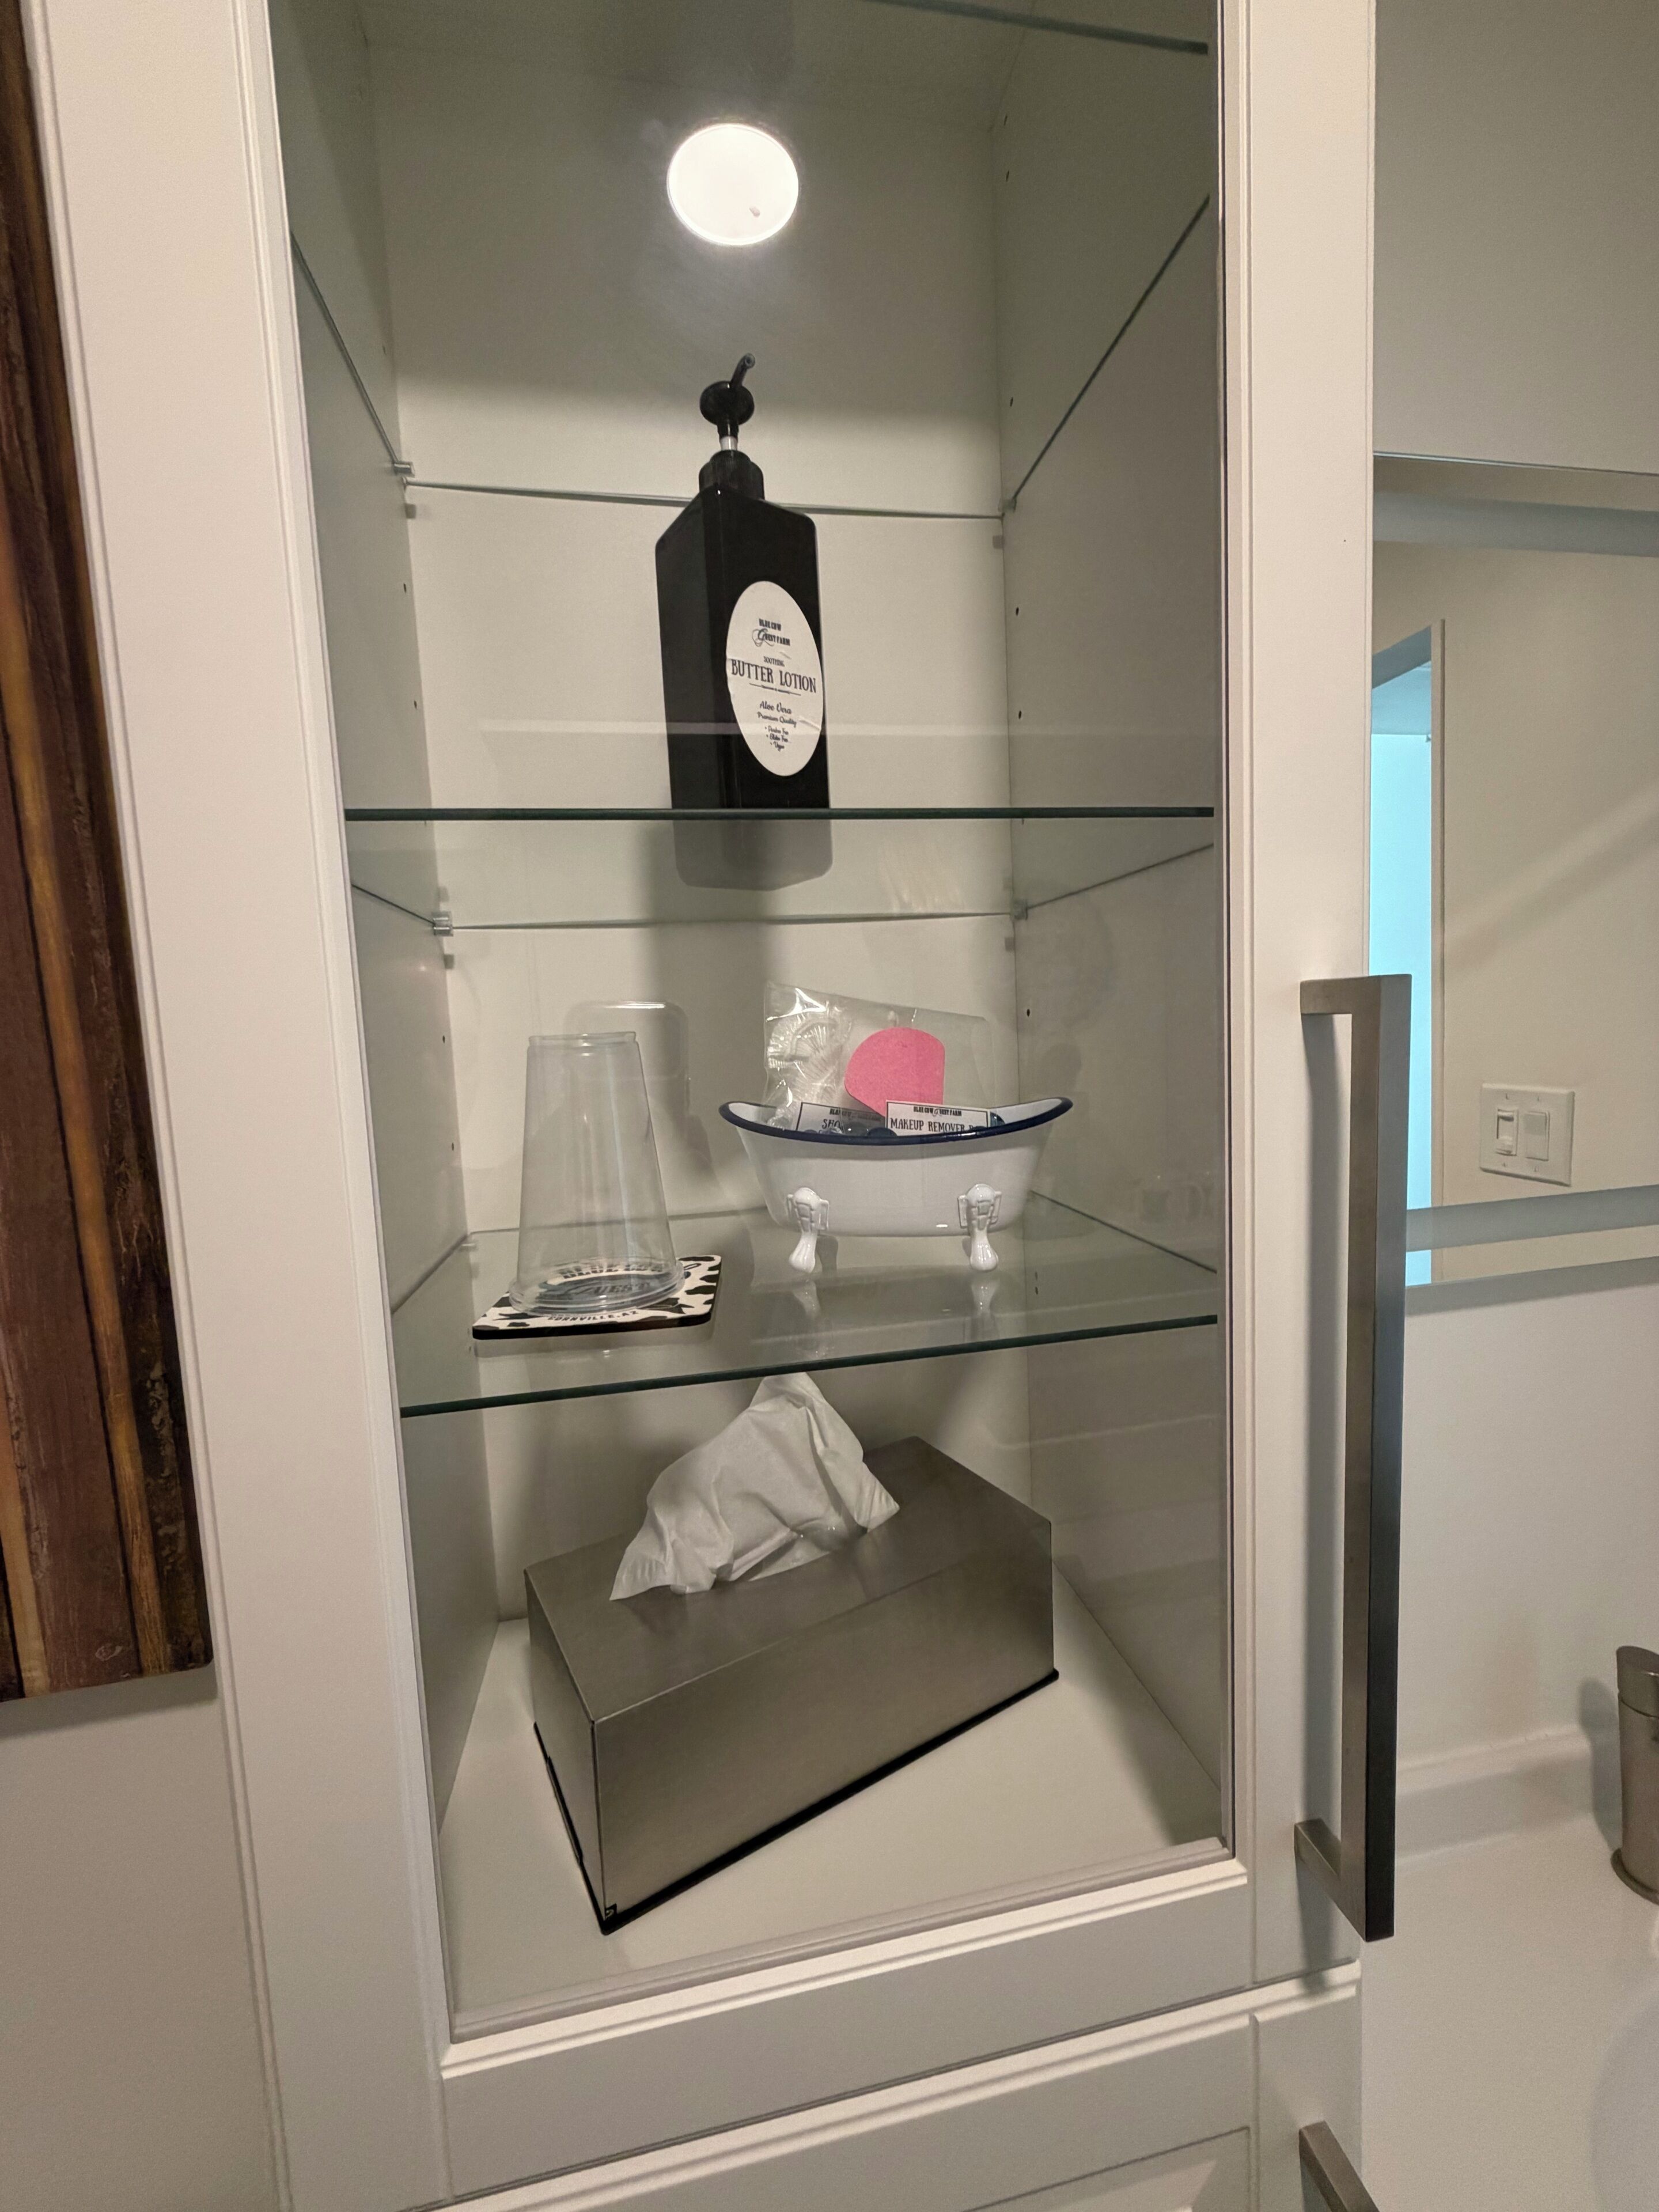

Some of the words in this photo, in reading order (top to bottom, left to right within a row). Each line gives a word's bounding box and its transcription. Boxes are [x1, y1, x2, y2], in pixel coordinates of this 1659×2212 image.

[777, 636, 790, 646] FARM
[731, 659, 774, 683] BUTTER
[779, 670, 816, 693] LOTION
[760, 700, 775, 711] Aloe
[777, 702, 792, 714] Vera
[779, 716, 797, 728] Quality
[890, 1118, 924, 1131] MAKEUP
[928, 1121, 965, 1132] REMOVER
